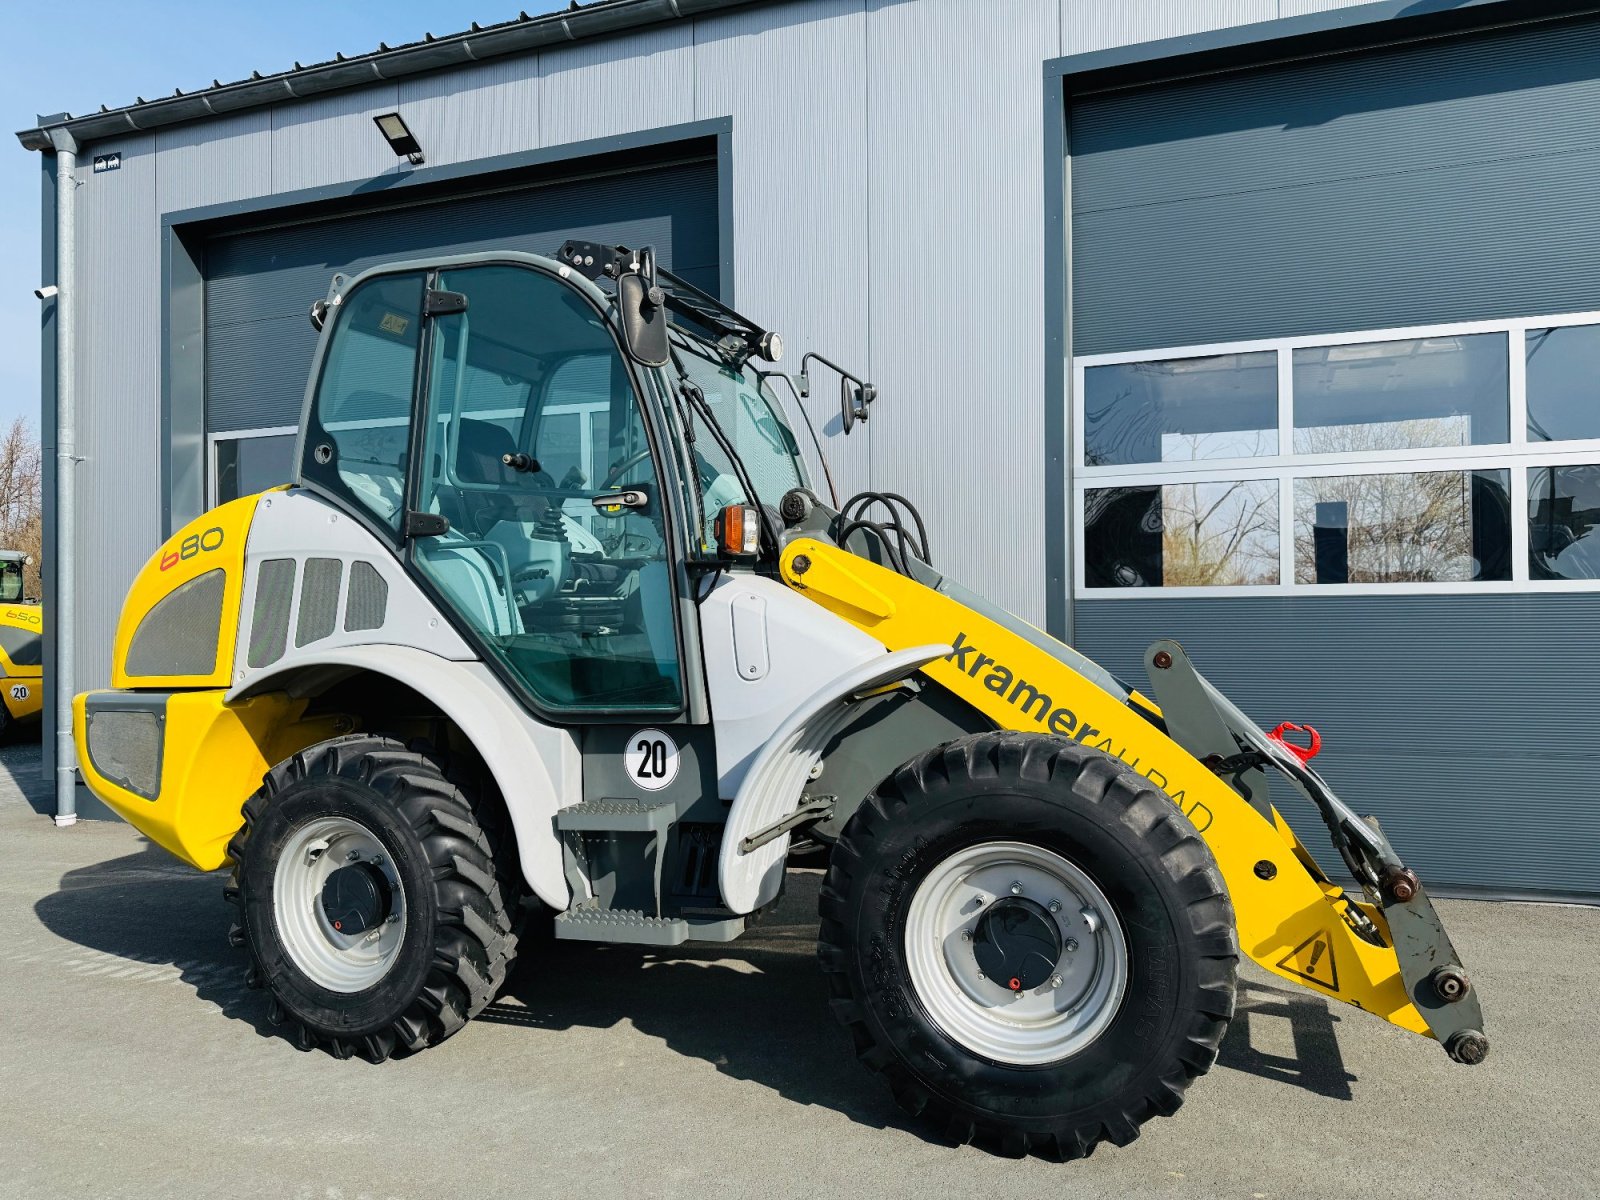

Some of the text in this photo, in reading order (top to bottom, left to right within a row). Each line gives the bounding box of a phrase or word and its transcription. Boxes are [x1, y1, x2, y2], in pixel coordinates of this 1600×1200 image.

[160, 526, 224, 572] 680
[6, 610, 40, 624] 650
[13, 686, 27, 700] 20
[637, 740, 666, 778] 20
